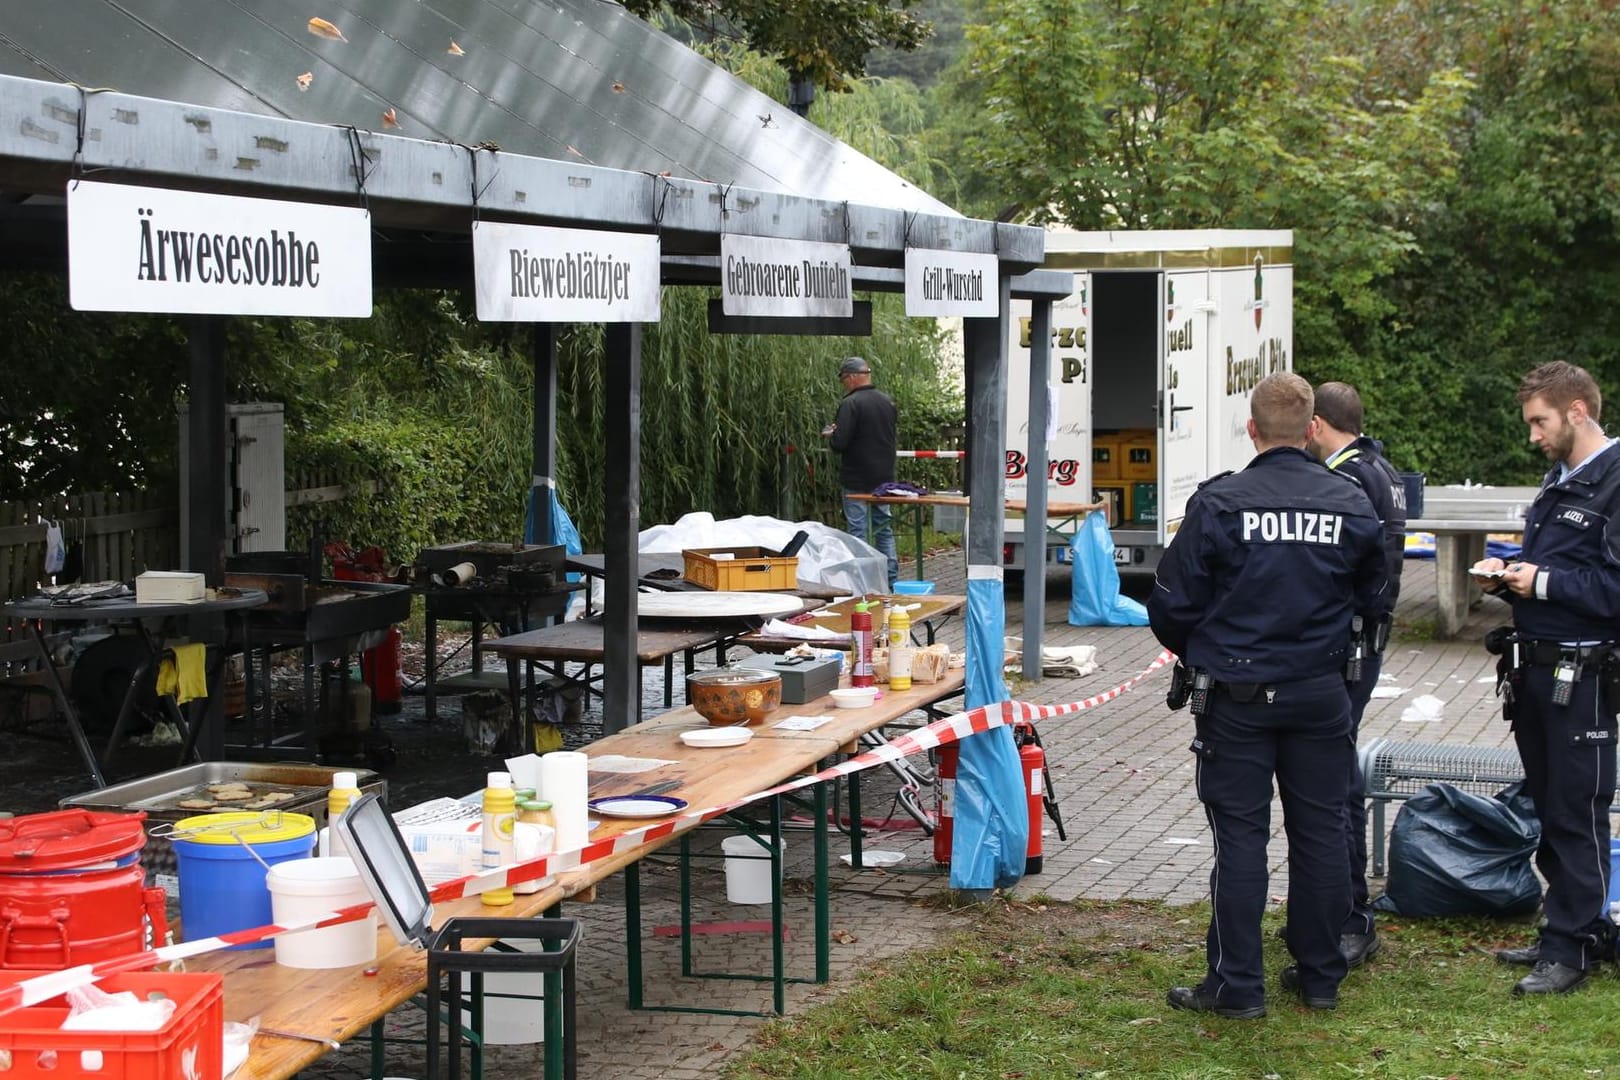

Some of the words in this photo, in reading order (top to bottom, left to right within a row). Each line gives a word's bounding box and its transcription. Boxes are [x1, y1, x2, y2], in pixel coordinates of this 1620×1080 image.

[137, 207, 320, 288] Ärwesesobbe
[509, 248, 631, 306] Rieweblätzjer
[727, 254, 800, 297] Gebroarene
[923, 266, 983, 301] Grill-Wurschd
[1005, 450, 1080, 486] Brg
[1243, 510, 1342, 545] POLIZEI
[1586, 730, 1609, 739] POLIZEI
